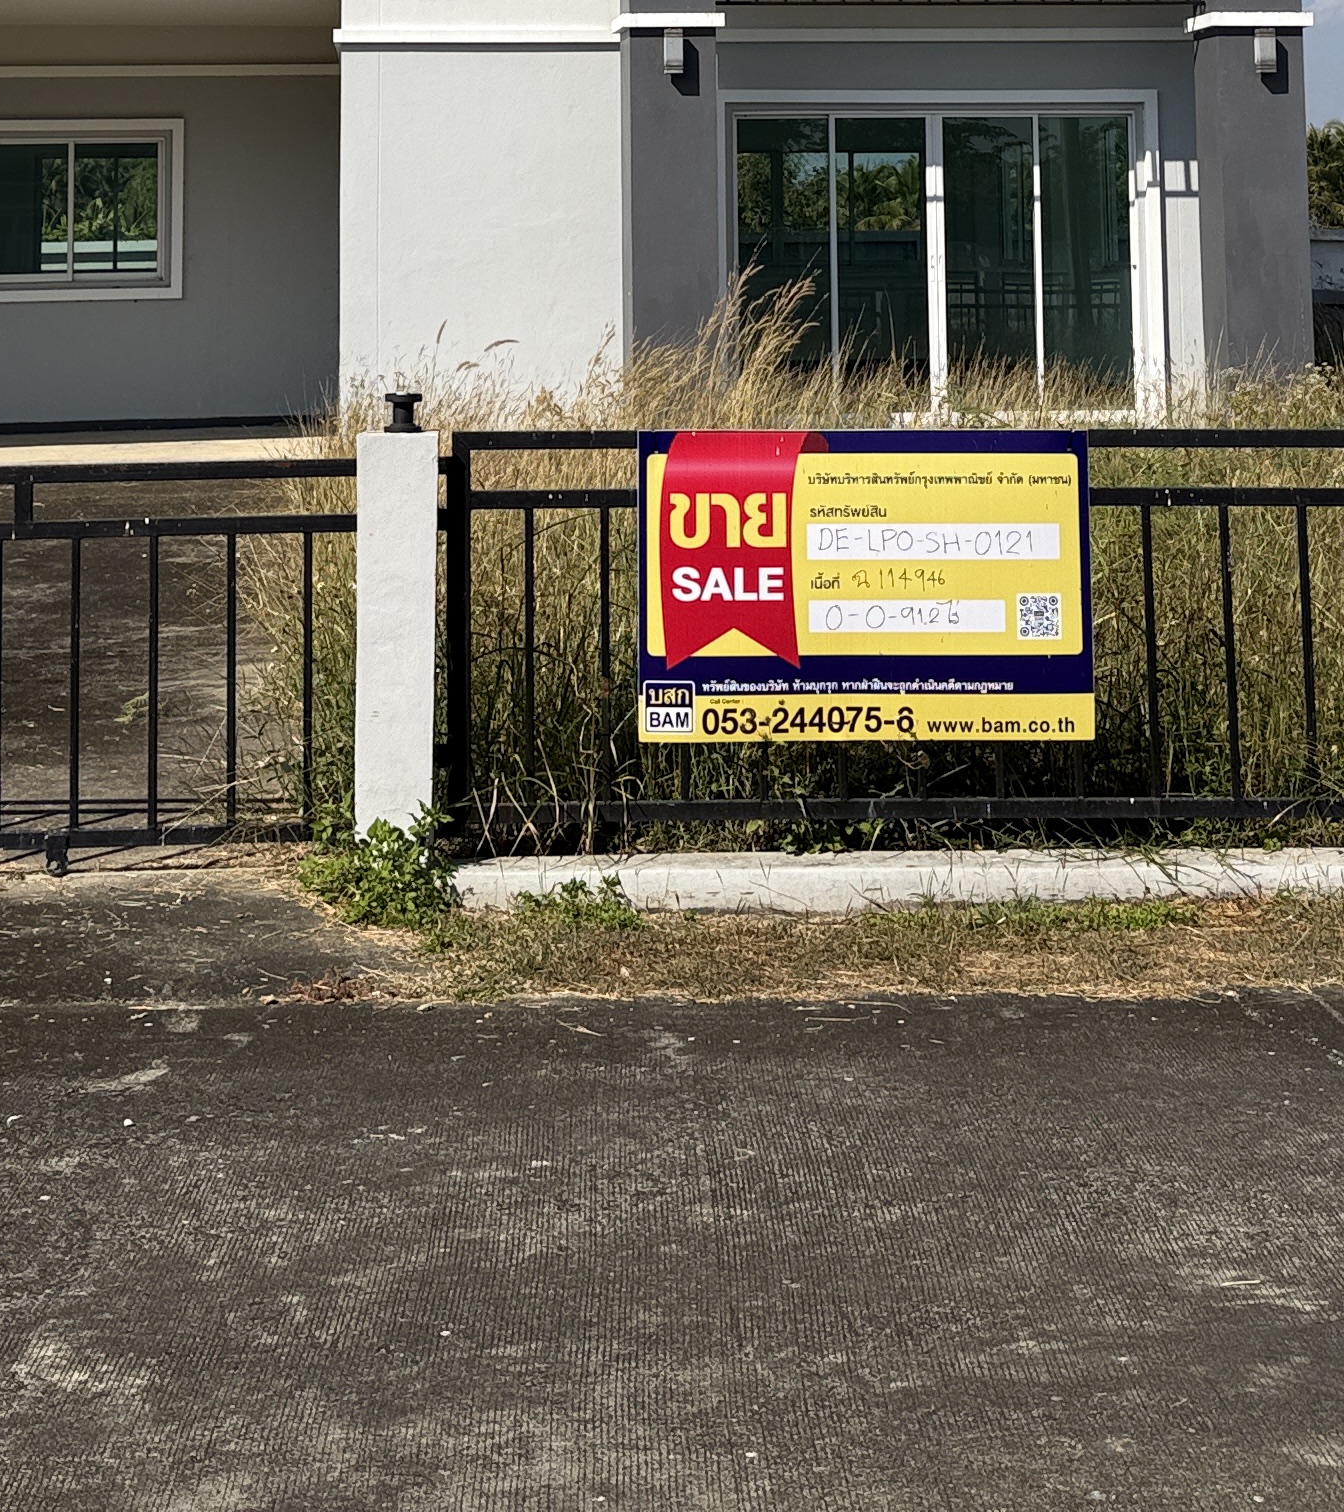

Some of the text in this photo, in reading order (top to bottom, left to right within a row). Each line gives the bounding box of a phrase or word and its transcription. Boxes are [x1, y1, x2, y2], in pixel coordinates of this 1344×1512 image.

[997, 472, 1024, 485] จำกัด
[1028, 474, 1072, 487] (มหาชน)
[810, 504, 887, 518] รหัสทรัพย์สิน
[669, 492, 787, 549] ขาย
[818, 527, 1033, 555] DE-LPO-SH-0121
[671, 566, 784, 602] SALE
[810, 572, 841, 590] เนื้อที่
[702, 678, 789, 692] ทรัพย์สินของบริษัท
[792, 678, 839, 695] ห้ามบุกรุก
[648, 687, 690, 705] บสก
[649, 711, 689, 728] BAM
[702, 706, 1075, 735] 053-244075-6 www.bam.co.th
